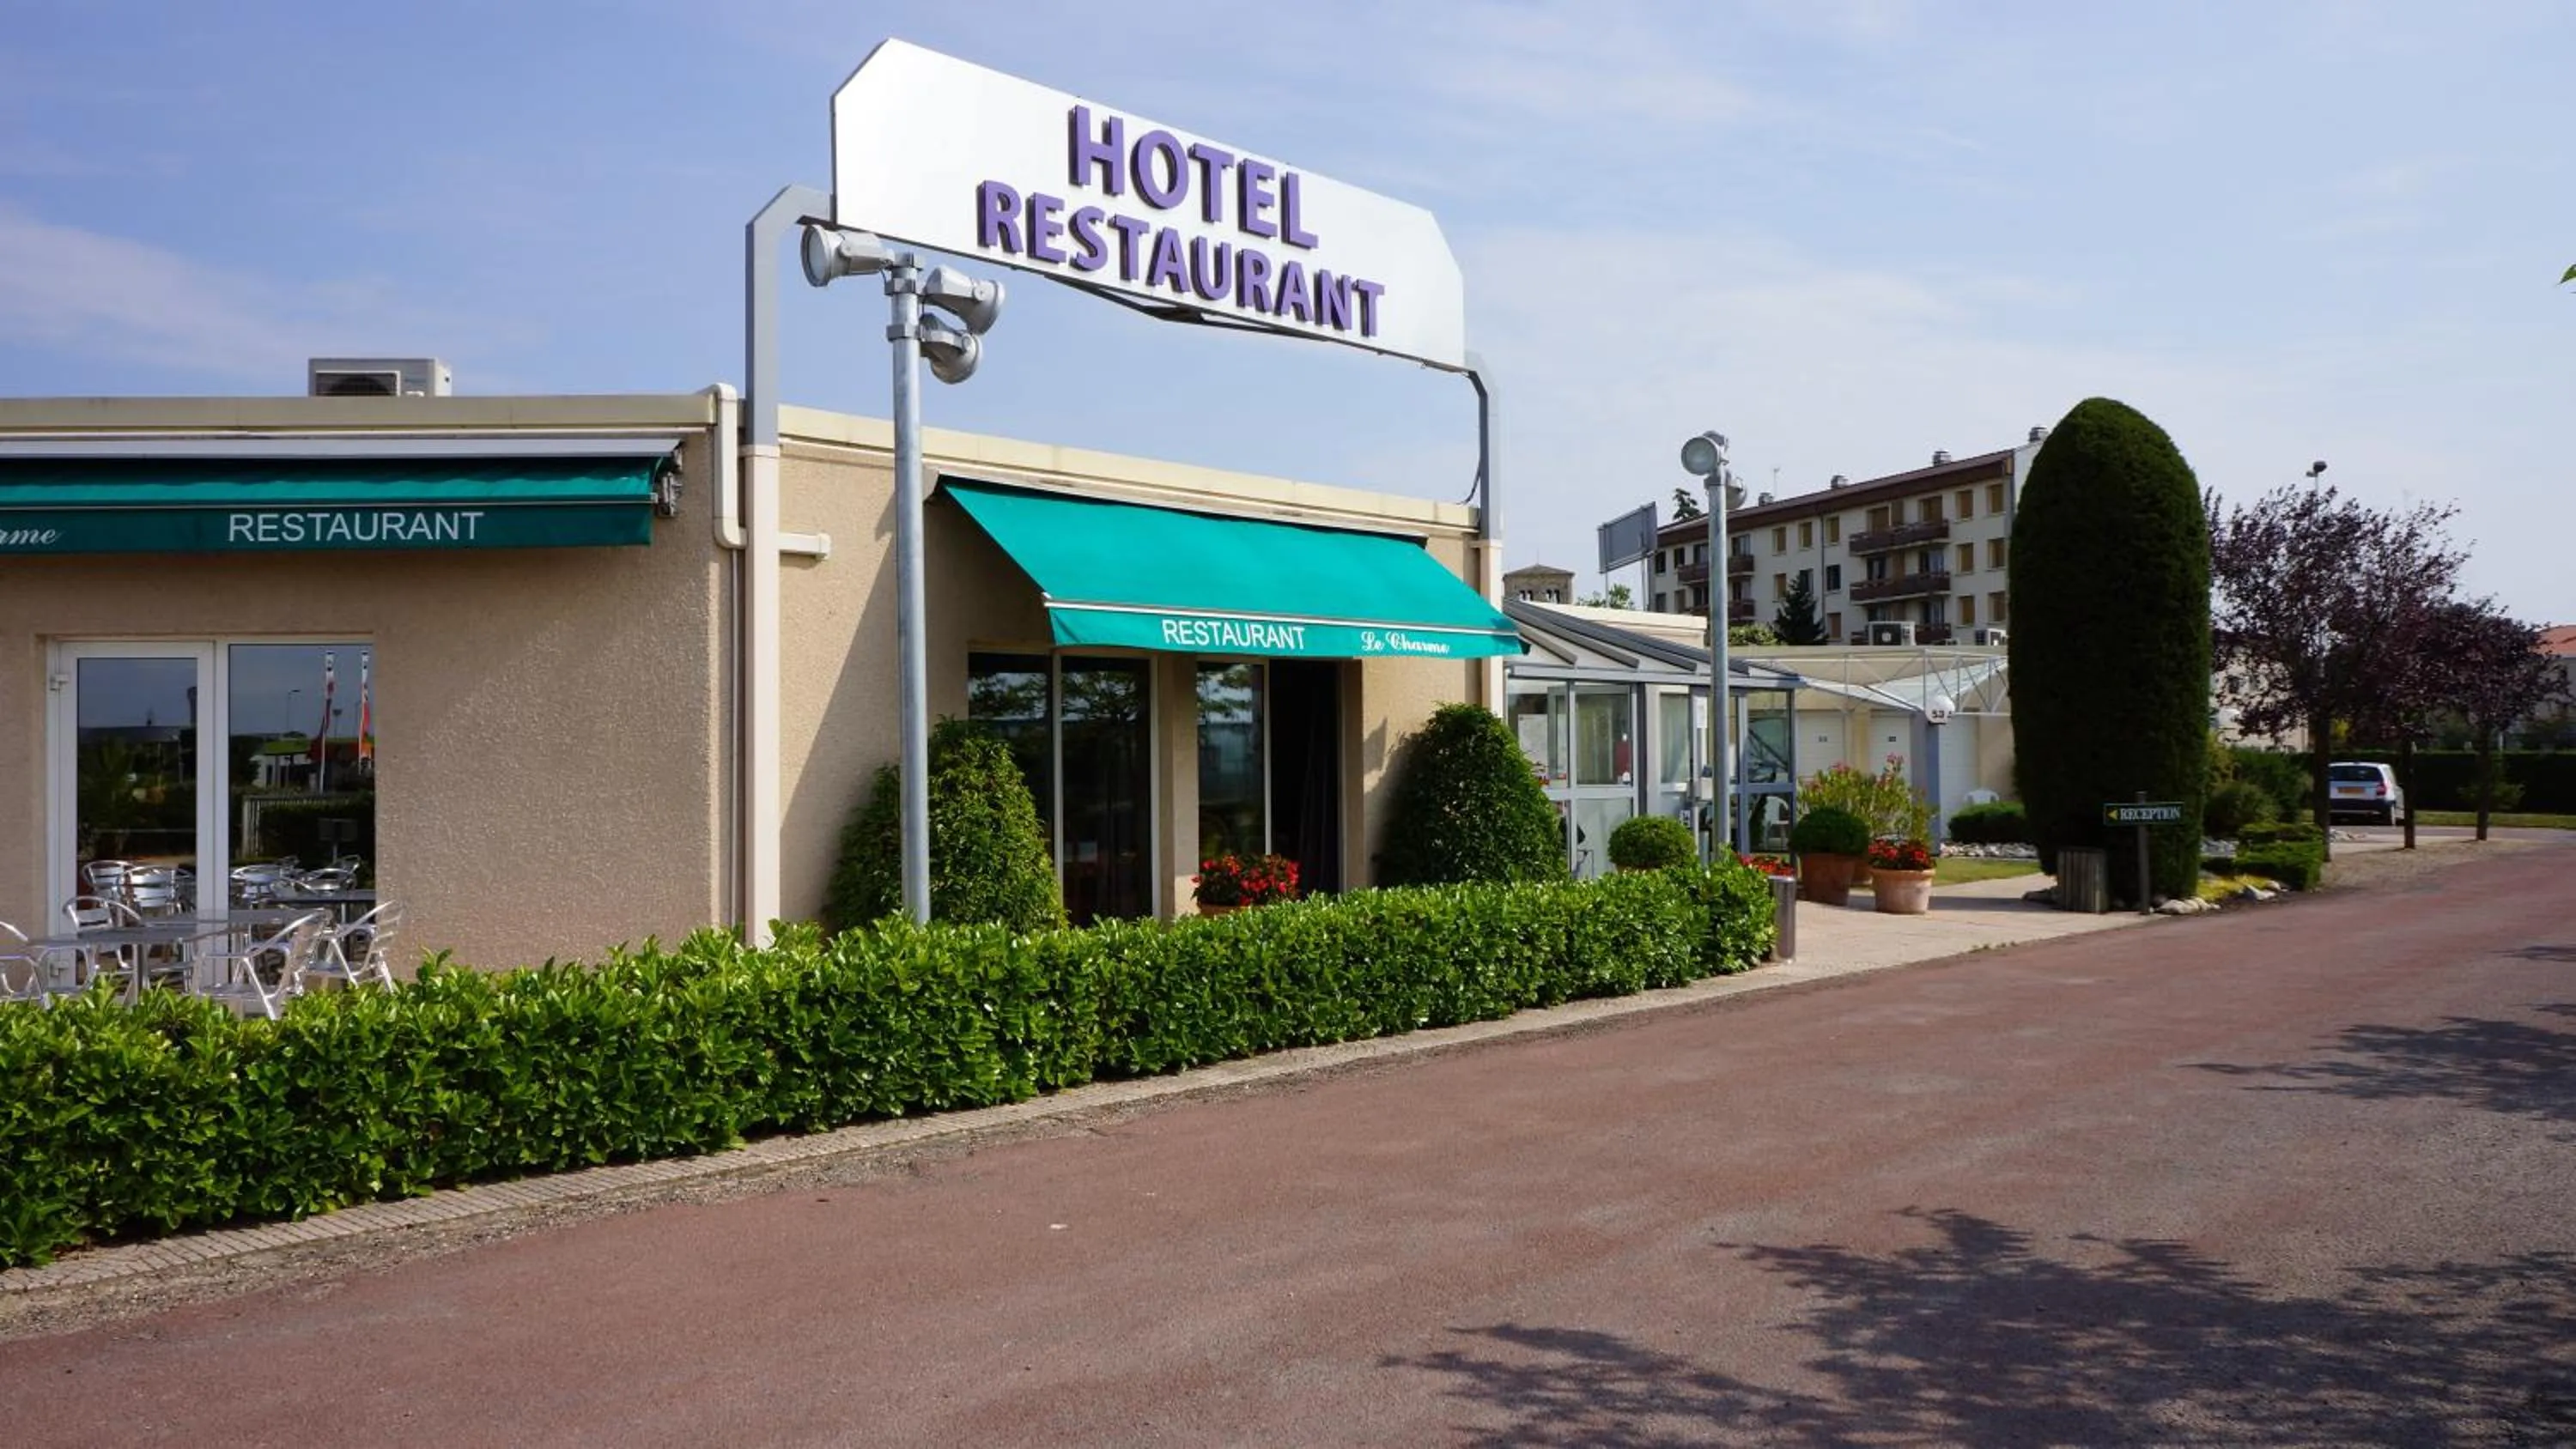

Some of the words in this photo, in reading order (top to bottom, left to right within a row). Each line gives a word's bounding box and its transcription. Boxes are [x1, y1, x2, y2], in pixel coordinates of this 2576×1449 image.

[1068, 104, 1319, 250] HOTEL
[975, 179, 1385, 337] RESTAURANT
[228, 512, 484, 543] RESTAURANT
[1162, 619, 1305, 650] RESTAURANT
[1360, 631, 1385, 652] Le
[1386, 631, 1450, 654] Charme
